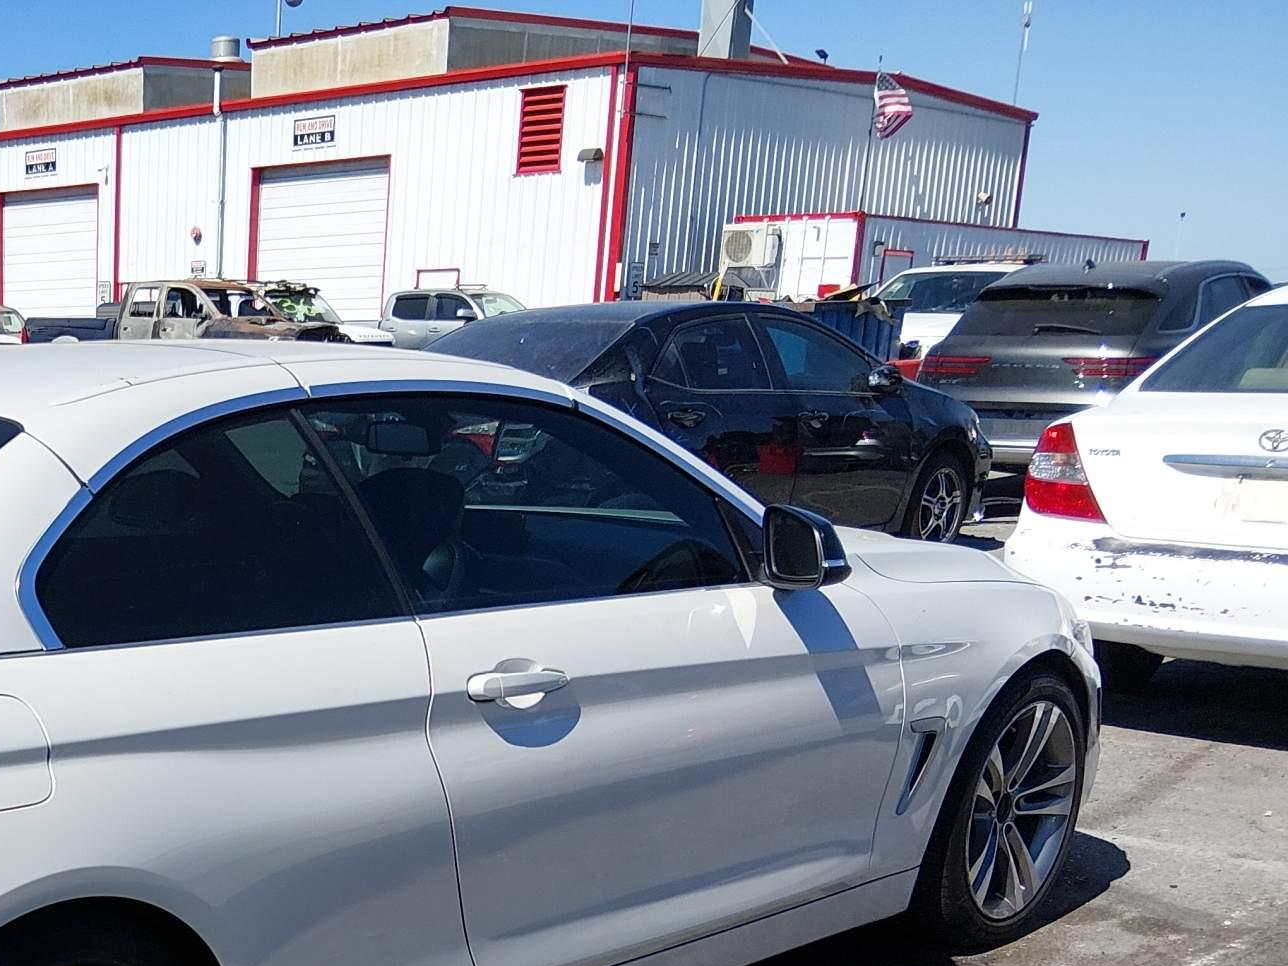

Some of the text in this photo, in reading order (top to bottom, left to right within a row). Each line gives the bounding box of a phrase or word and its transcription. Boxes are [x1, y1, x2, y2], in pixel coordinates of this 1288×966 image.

[297, 132, 331, 145] LANE B
[27, 163, 47, 174] LANE
[631, 281, 639, 294] 5
[1088, 448, 1121, 457] TOYOTA
